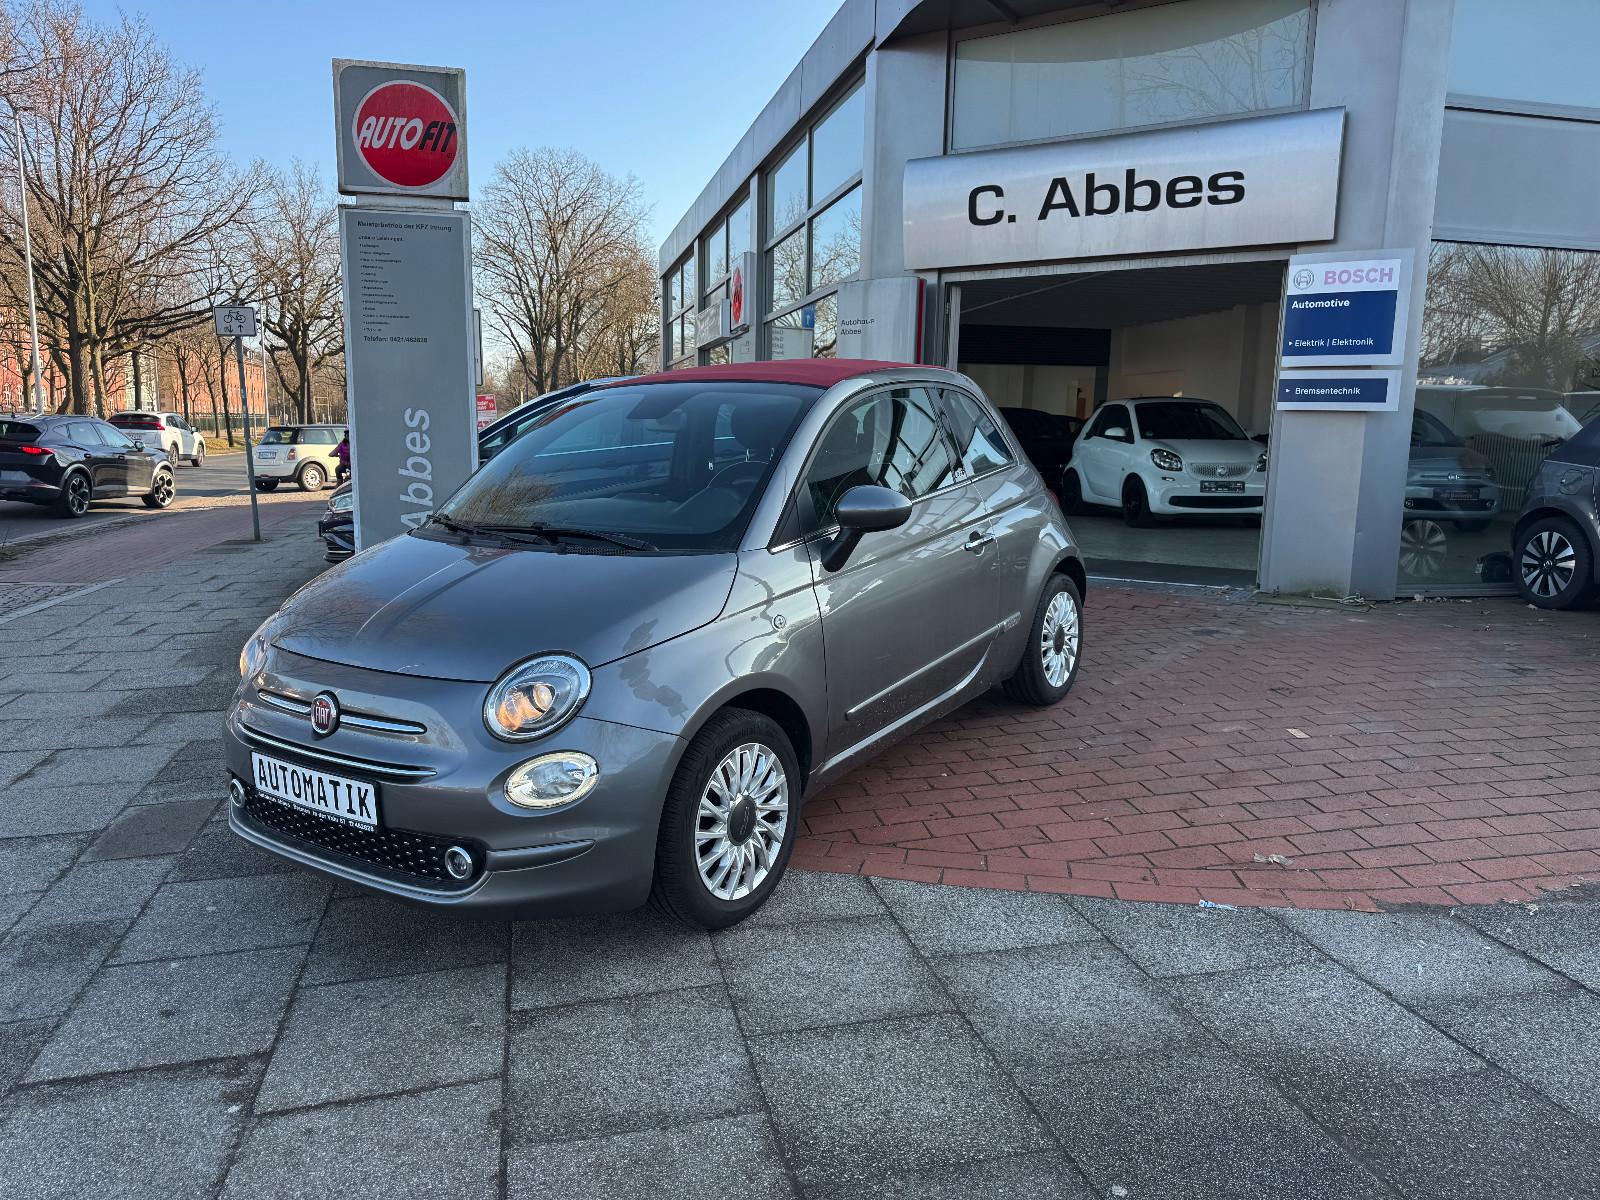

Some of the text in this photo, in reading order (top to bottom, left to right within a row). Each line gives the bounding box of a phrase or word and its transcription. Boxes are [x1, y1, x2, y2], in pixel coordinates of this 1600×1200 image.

[358, 115, 457, 152] AUTOFIT
[967, 168, 1246, 226] C. Abbes
[1323, 267, 1394, 286] BOSCH
[1291, 298, 1351, 309] Automotive
[1294, 338, 1325, 347] Elektrik
[1331, 337, 1374, 346] Elektronik
[1295, 387, 1361, 396] Bremsentechnik
[315, 706, 330, 725] FIAT
[258, 758, 372, 820] AUTOMATIK
